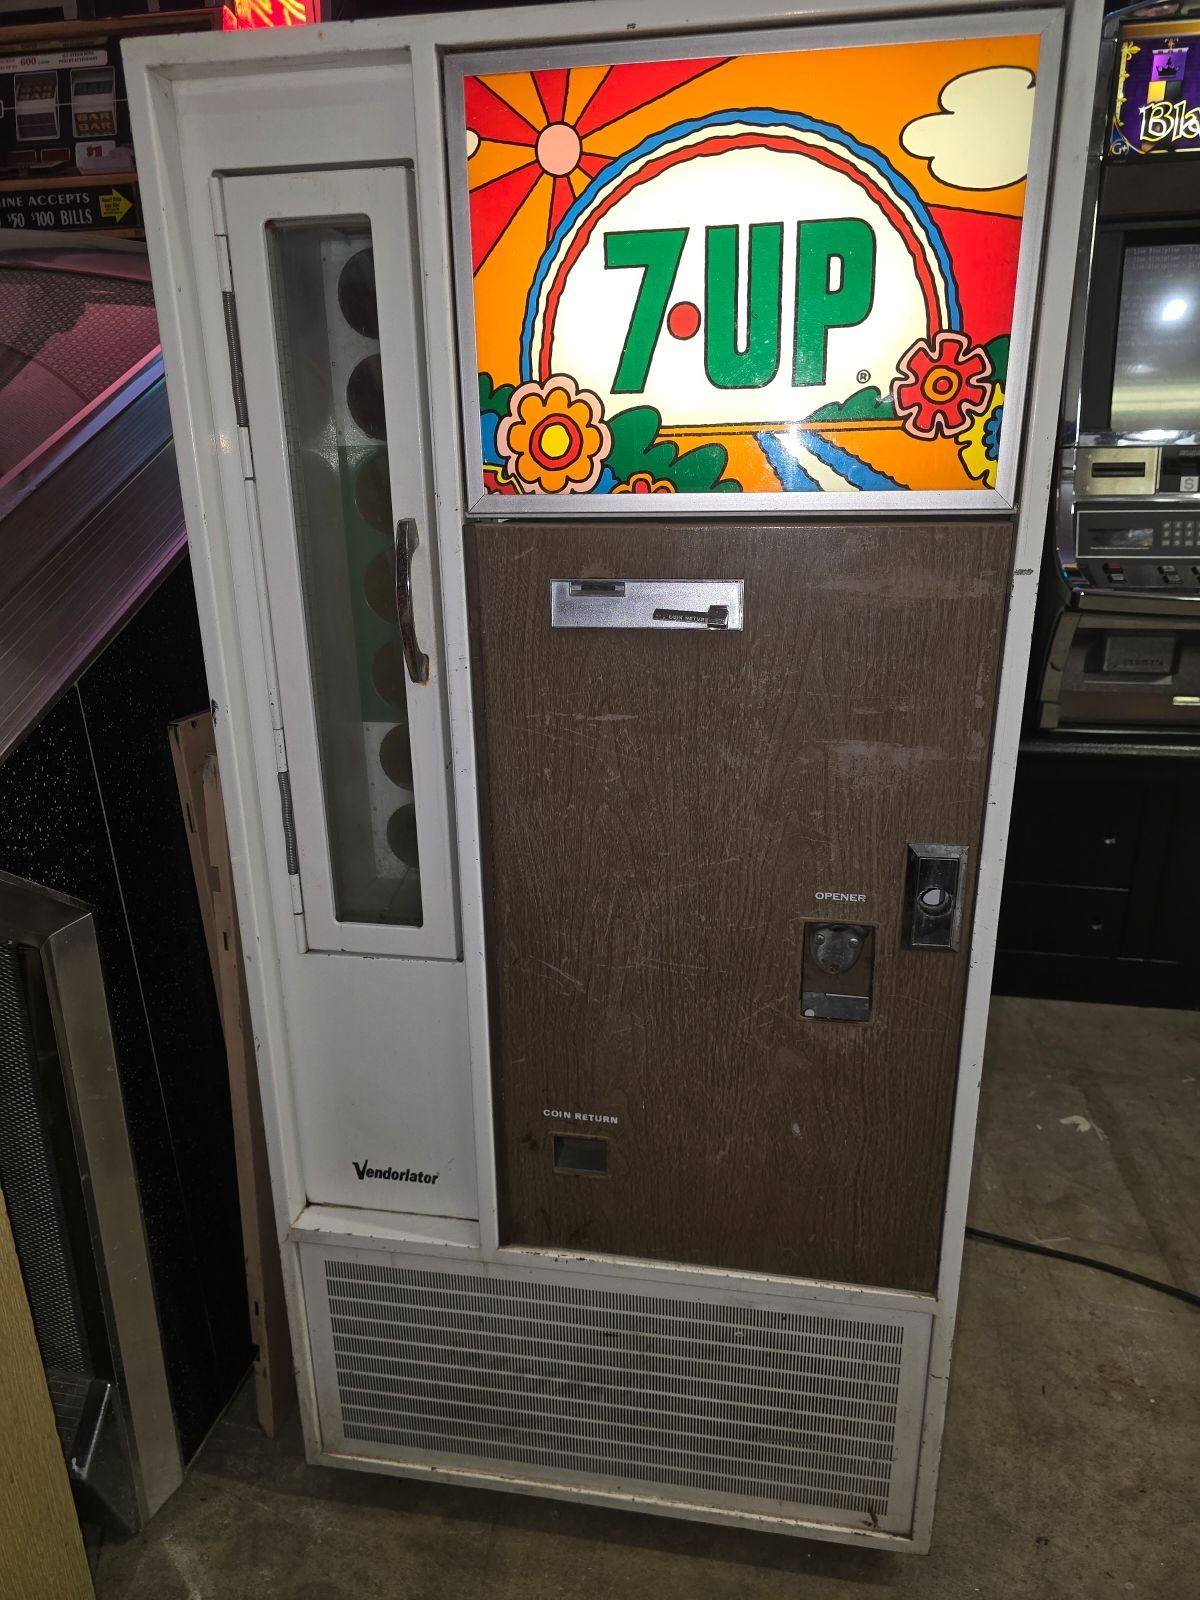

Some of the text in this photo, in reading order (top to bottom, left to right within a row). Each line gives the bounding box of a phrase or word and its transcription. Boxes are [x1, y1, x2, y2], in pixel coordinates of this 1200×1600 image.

[20, 57, 37, 66] 600
[77, 112, 110, 121] BAR
[78, 122, 112, 131] BAR
[28, 193, 91, 206] ACCEPTS
[7, 208, 93, 228] $50 $100 BILLS
[815, 891, 867, 902] OPENER
[543, 1109, 618, 1124] COIN RETURN
[352, 1160, 439, 1185] Vendorlator
